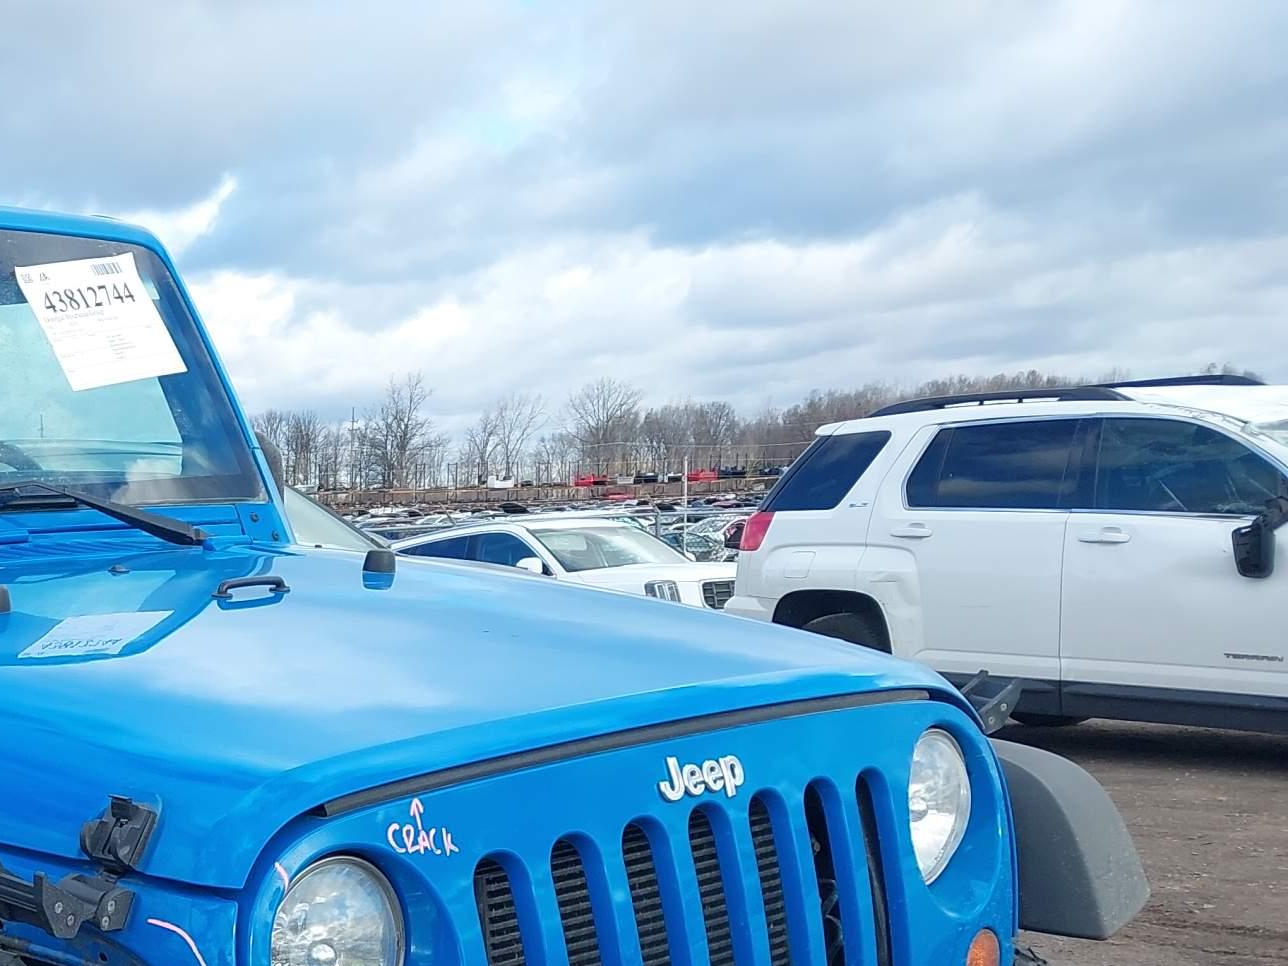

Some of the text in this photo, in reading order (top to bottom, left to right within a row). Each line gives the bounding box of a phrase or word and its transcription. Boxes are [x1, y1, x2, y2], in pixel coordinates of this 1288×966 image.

[44, 282, 135, 313] 43812744
[659, 754, 745, 801] Jeep
[387, 824, 459, 855] CRACK
